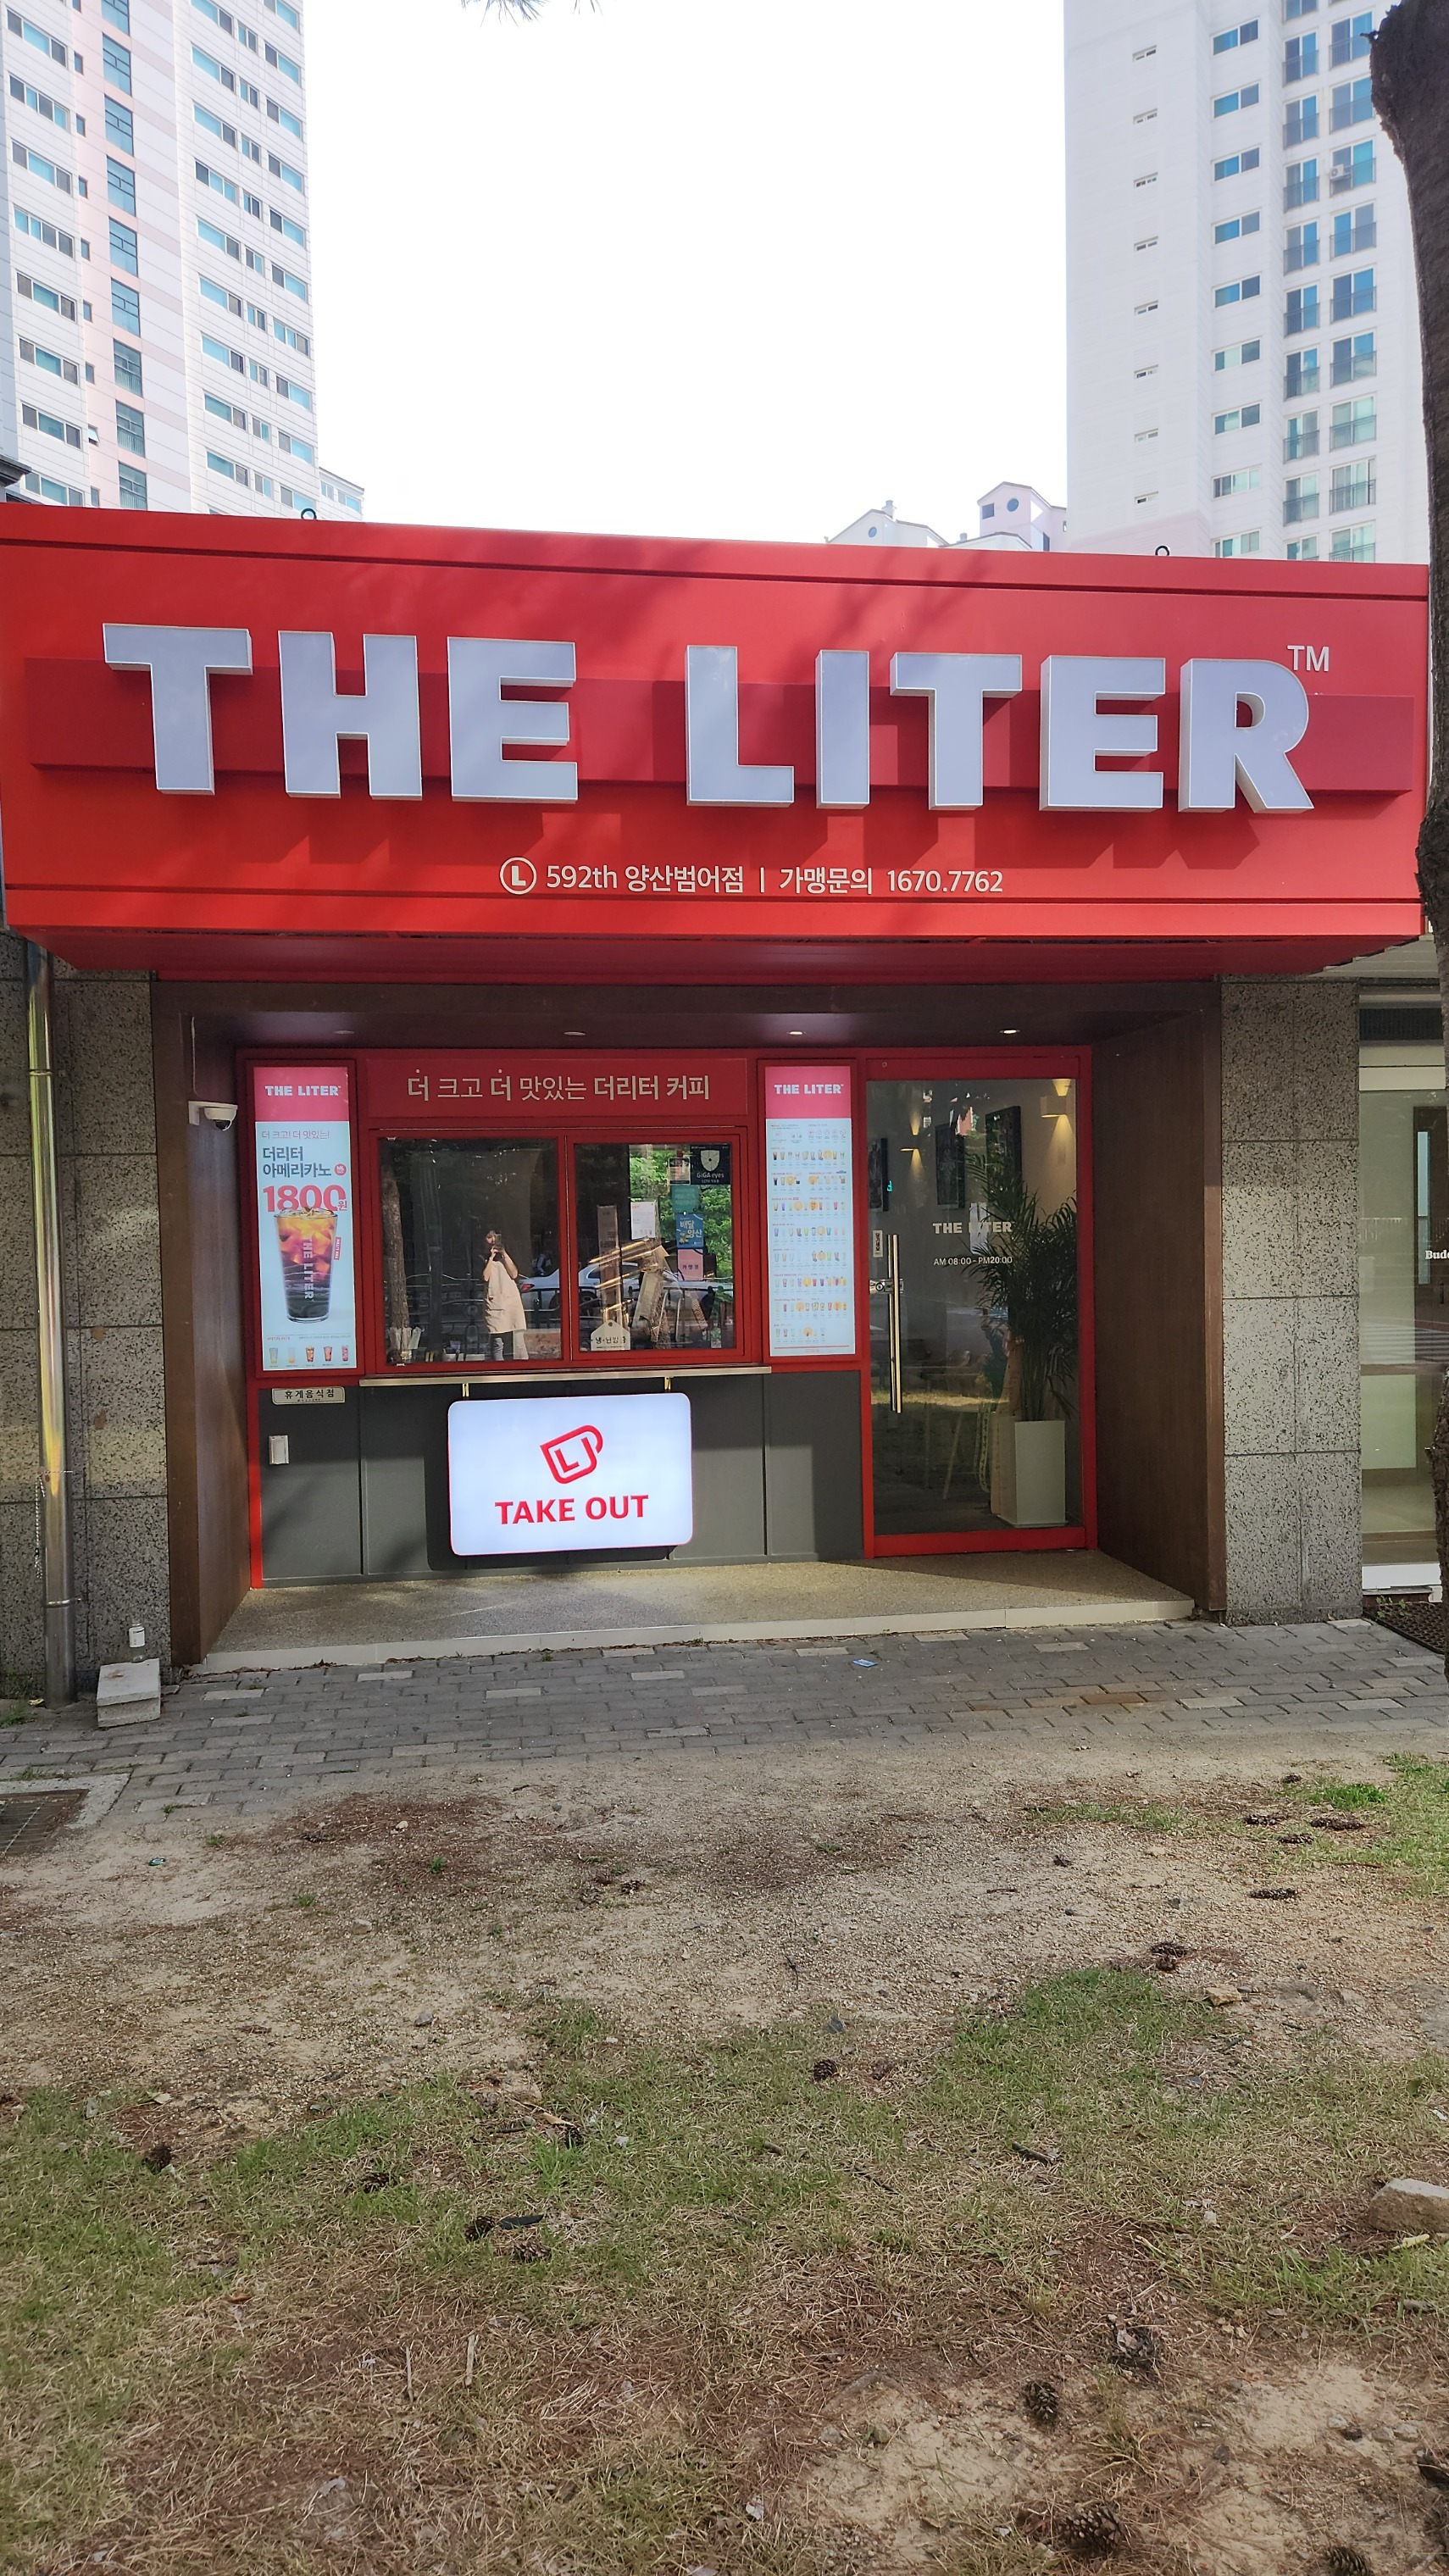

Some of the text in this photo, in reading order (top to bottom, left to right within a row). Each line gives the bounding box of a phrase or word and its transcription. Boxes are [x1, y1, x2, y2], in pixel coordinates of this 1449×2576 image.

[1286, 645, 1330, 672] TM
[103, 623, 1314, 813] THE LITER
[547, 865, 618, 889] 592th
[625, 865, 744, 893] 양산범어점
[780, 867, 872, 895] 가맹문의
[887, 869, 1003, 892] 1670.7762
[264, 1085, 339, 1096] THE LITER
[408, 1069, 710, 1101] 더 크고 더 맛있는 더리터 커피
[774, 1084, 841, 1094] THE LITER
[262, 1130, 269, 1139] 더
[293, 1130, 301, 1139] 더
[263, 1146, 303, 1162] 더리터
[263, 1162, 332, 1178] 아메리카노
[680, 1219, 695, 1230] 배달
[932, 1222, 963, 1234] THE
[303, 1263, 314, 1300] LITER
[285, 1389, 335, 1399] 휴게음식점
[494, 1494, 649, 1525] TAKE OUT
